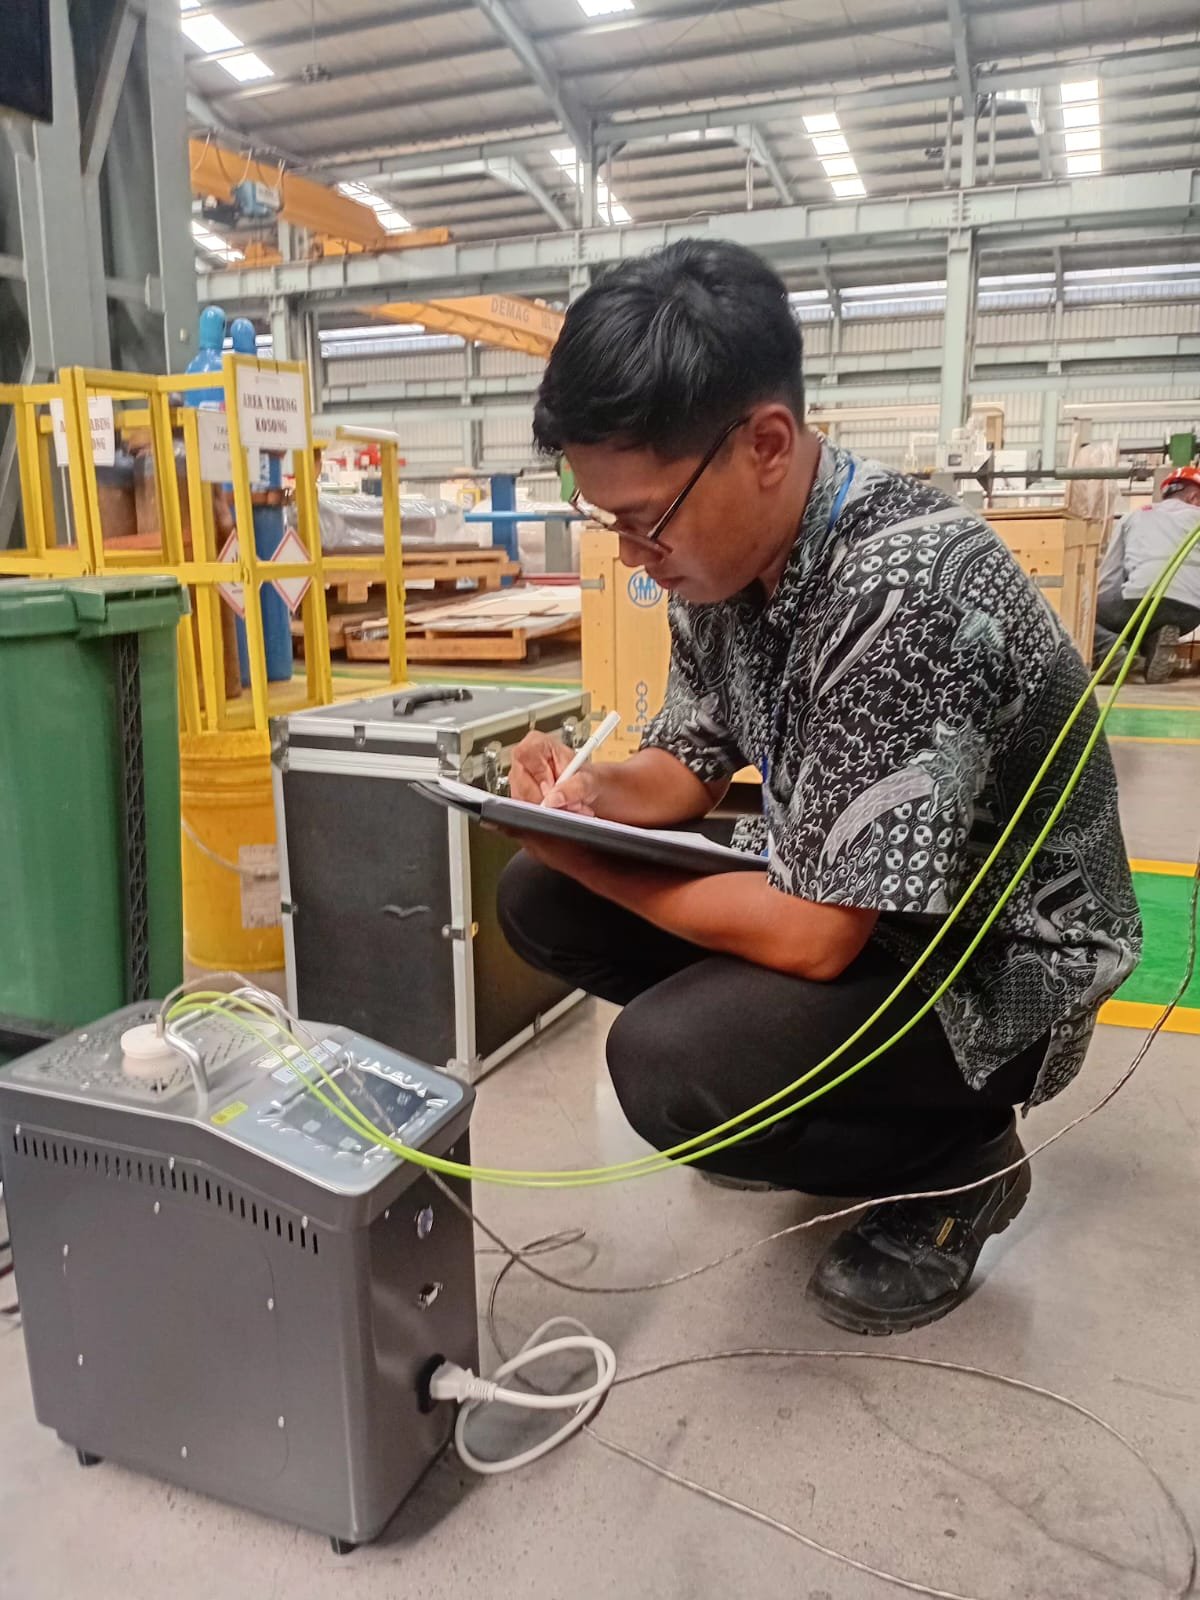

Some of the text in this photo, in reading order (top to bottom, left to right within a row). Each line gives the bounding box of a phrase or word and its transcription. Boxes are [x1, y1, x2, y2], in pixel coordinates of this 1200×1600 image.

[491, 296, 529, 323] DEMAG
[243, 392, 297, 413] AREA TABUNG
[255, 417, 287, 434] KOSONG
